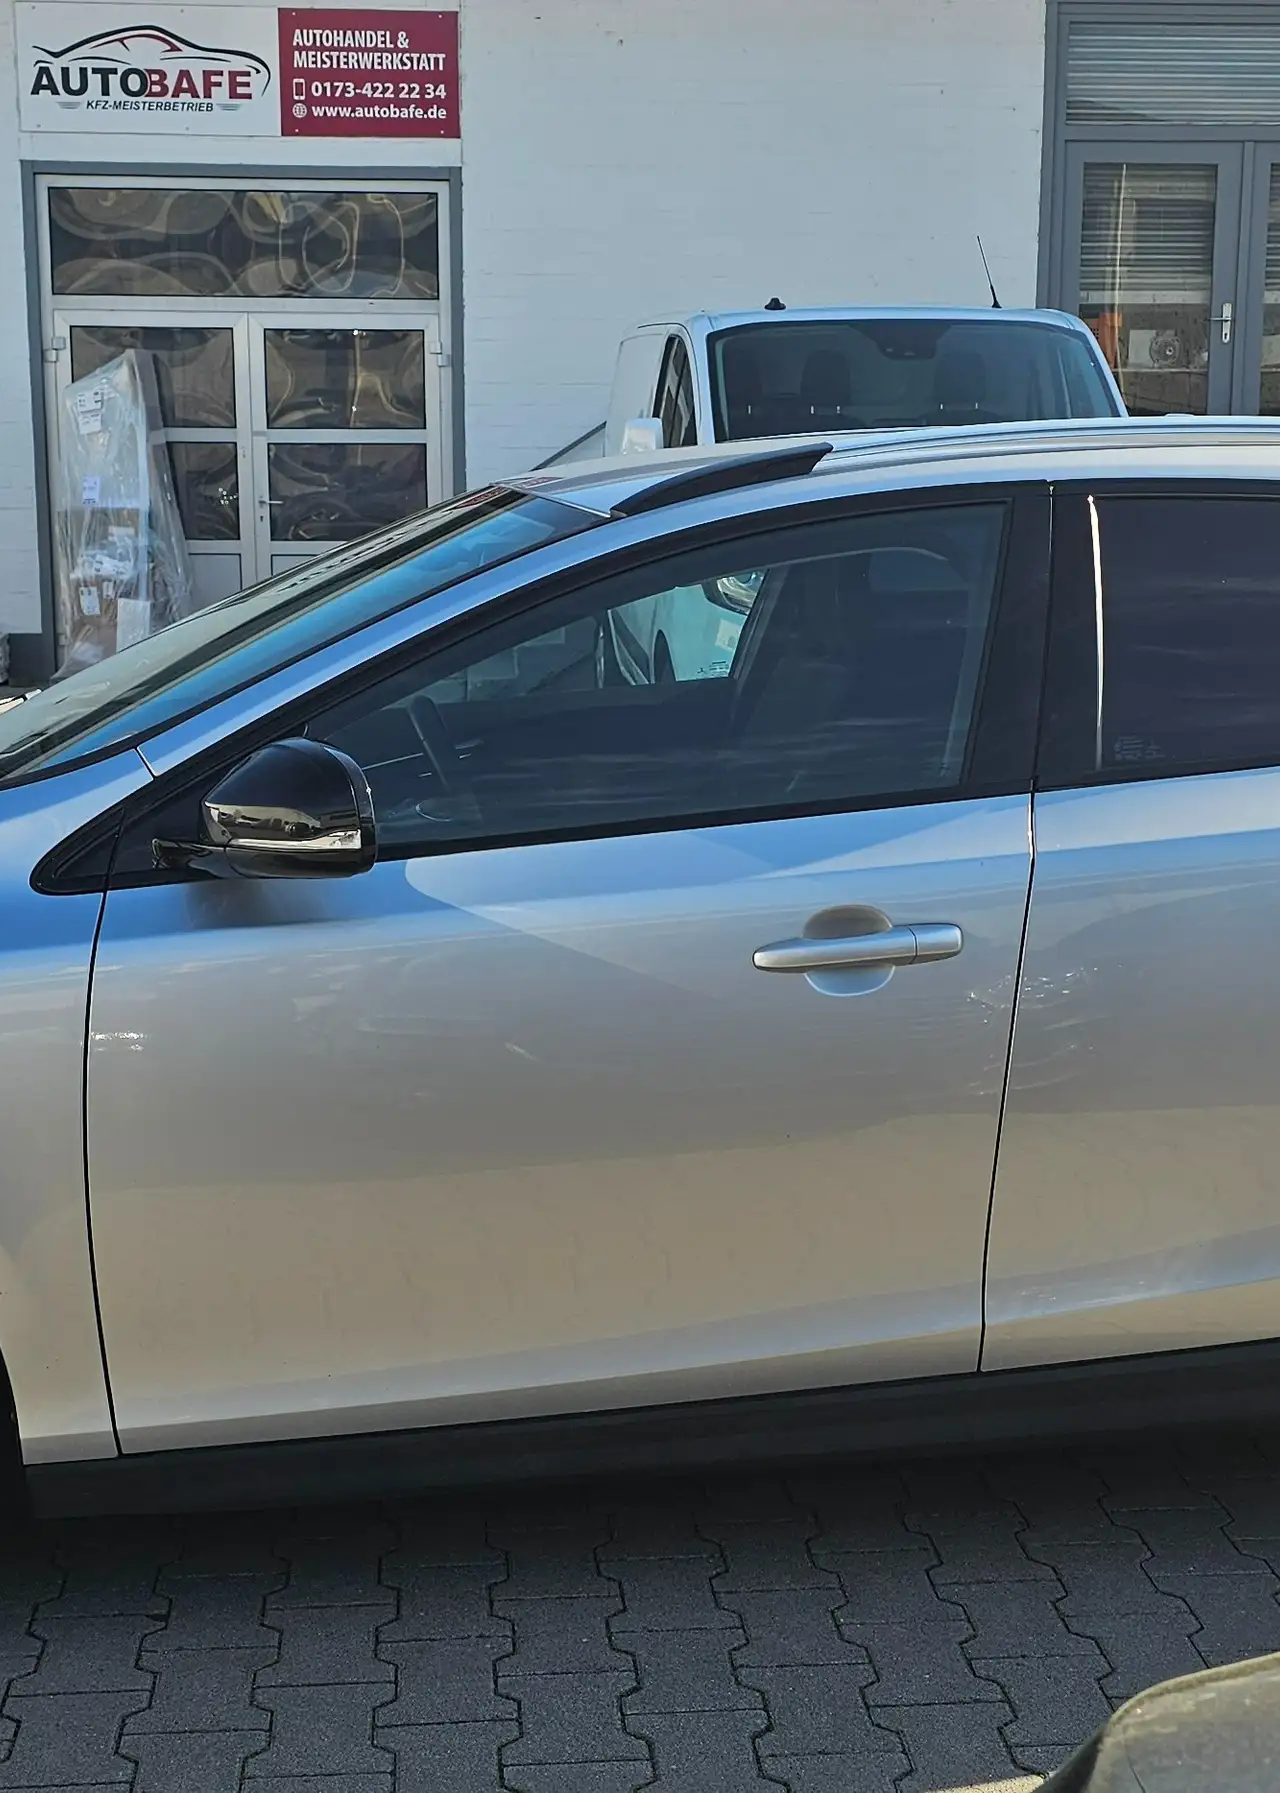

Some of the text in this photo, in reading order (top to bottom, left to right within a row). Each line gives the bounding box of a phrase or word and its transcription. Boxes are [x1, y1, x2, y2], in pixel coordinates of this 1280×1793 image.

[292, 28, 409, 48] AUTOHANDEL &
[293, 50, 446, 71] MEISTERWERKSTATT
[30, 66, 252, 100] AUTOBAFE
[311, 81, 447, 99] 0173-422 22 34
[86, 100, 214, 112] KFZ-MEISTERBETRIEB
[311, 103, 447, 119] www.autobafe.de
